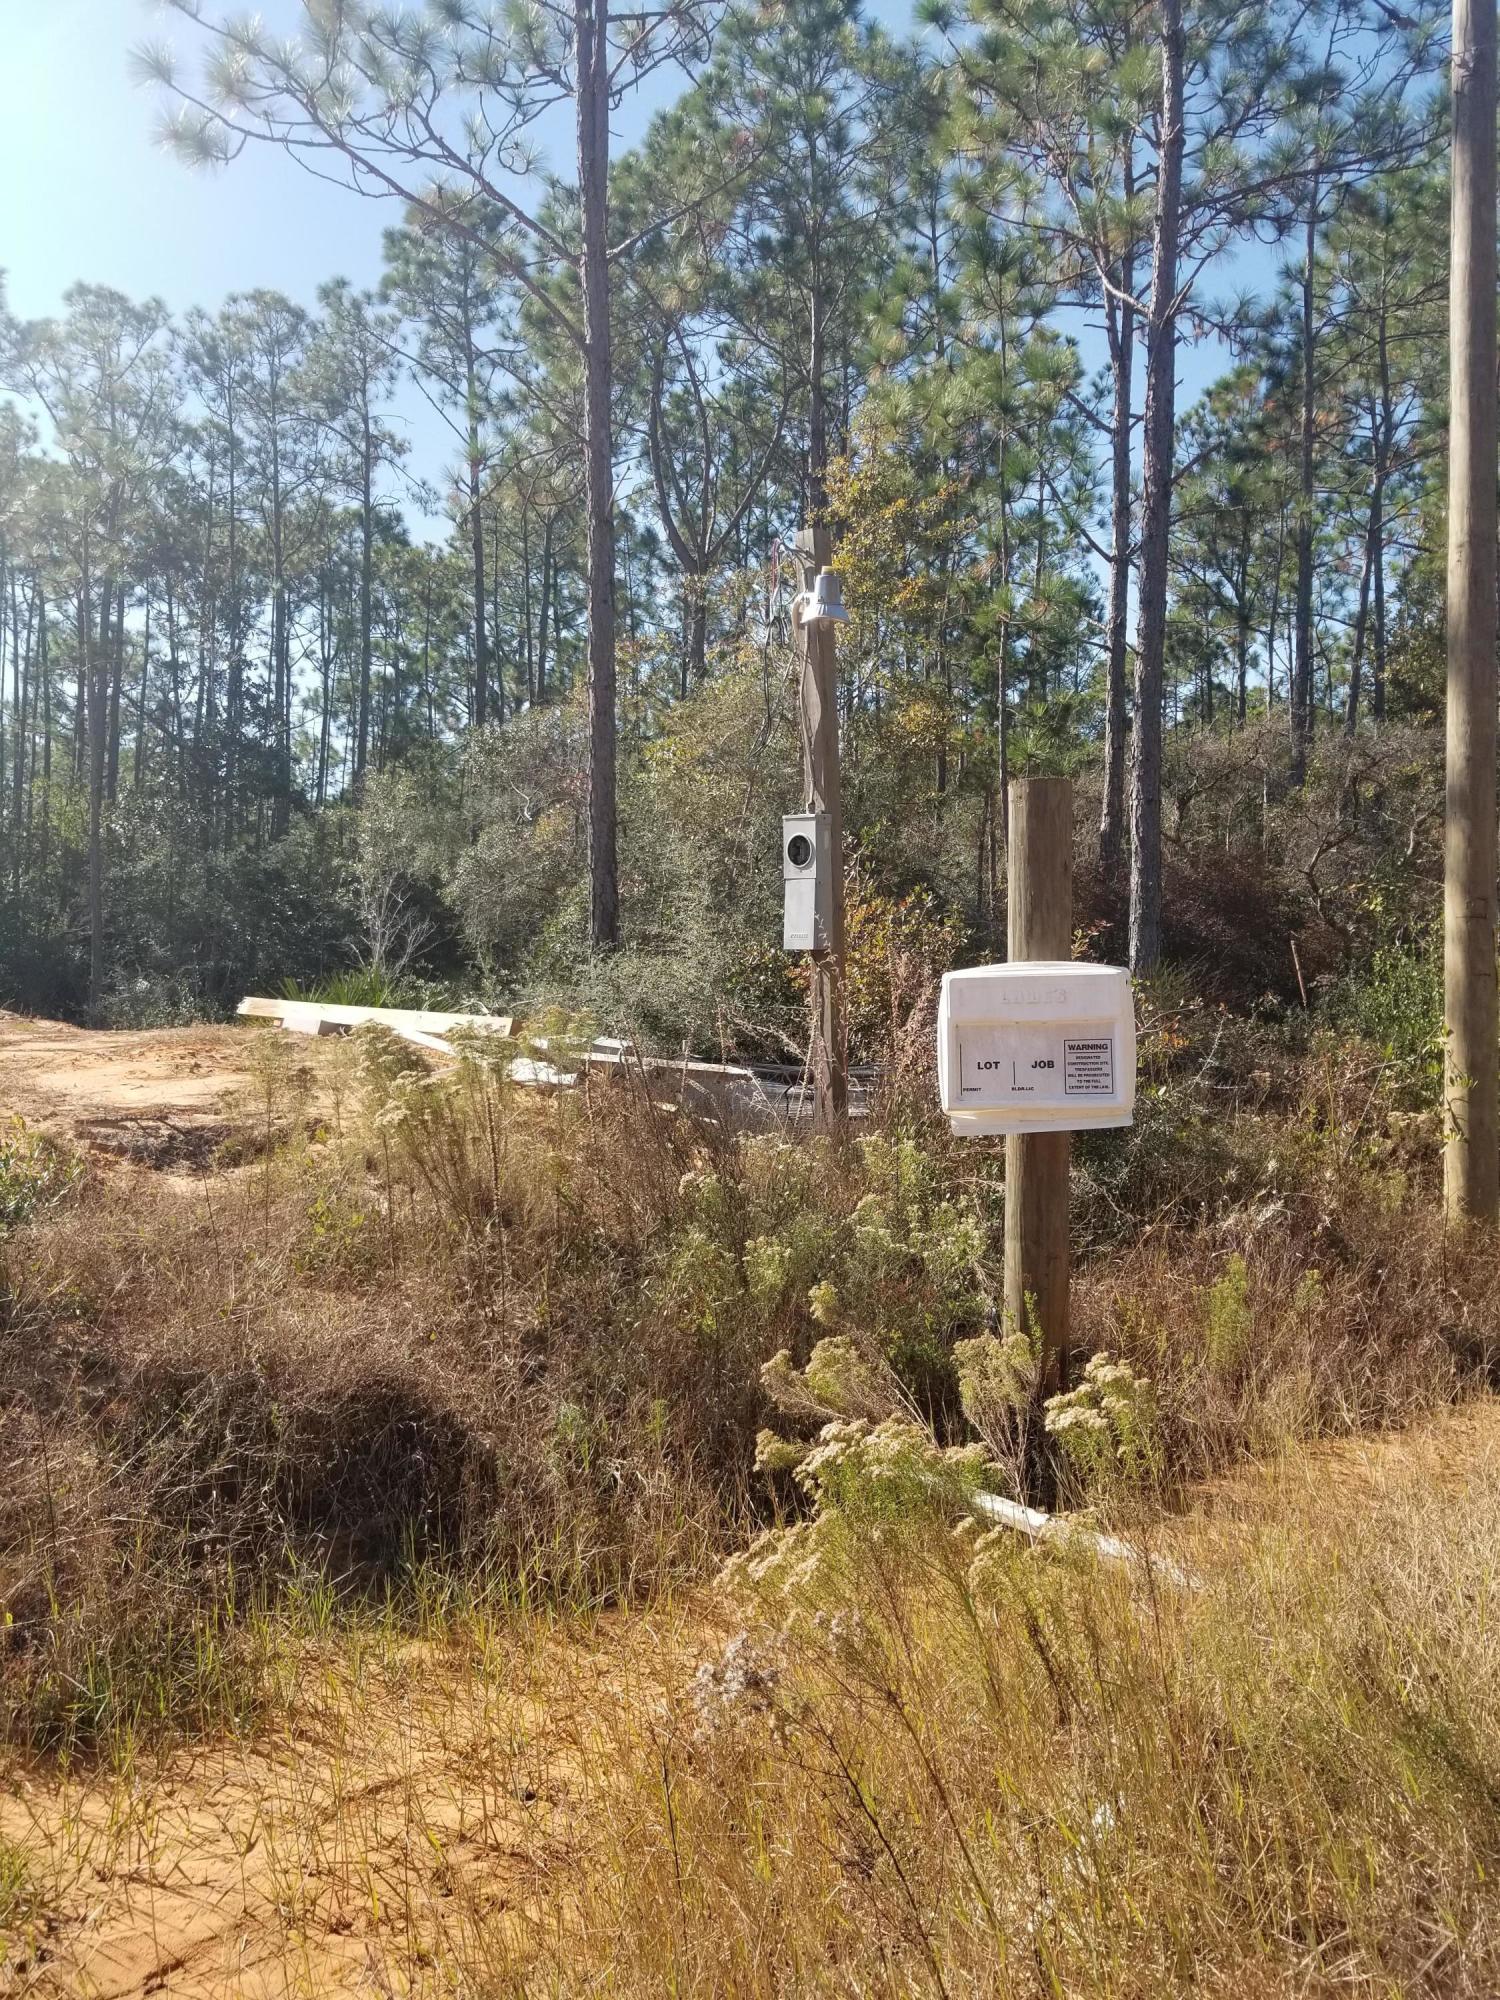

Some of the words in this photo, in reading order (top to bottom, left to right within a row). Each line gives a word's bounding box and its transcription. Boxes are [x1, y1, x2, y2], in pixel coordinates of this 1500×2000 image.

[1067, 1043, 1109, 1051] WARNING
[977, 1061, 1000, 1070] LOT
[1031, 1060, 1055, 1069] JOB
